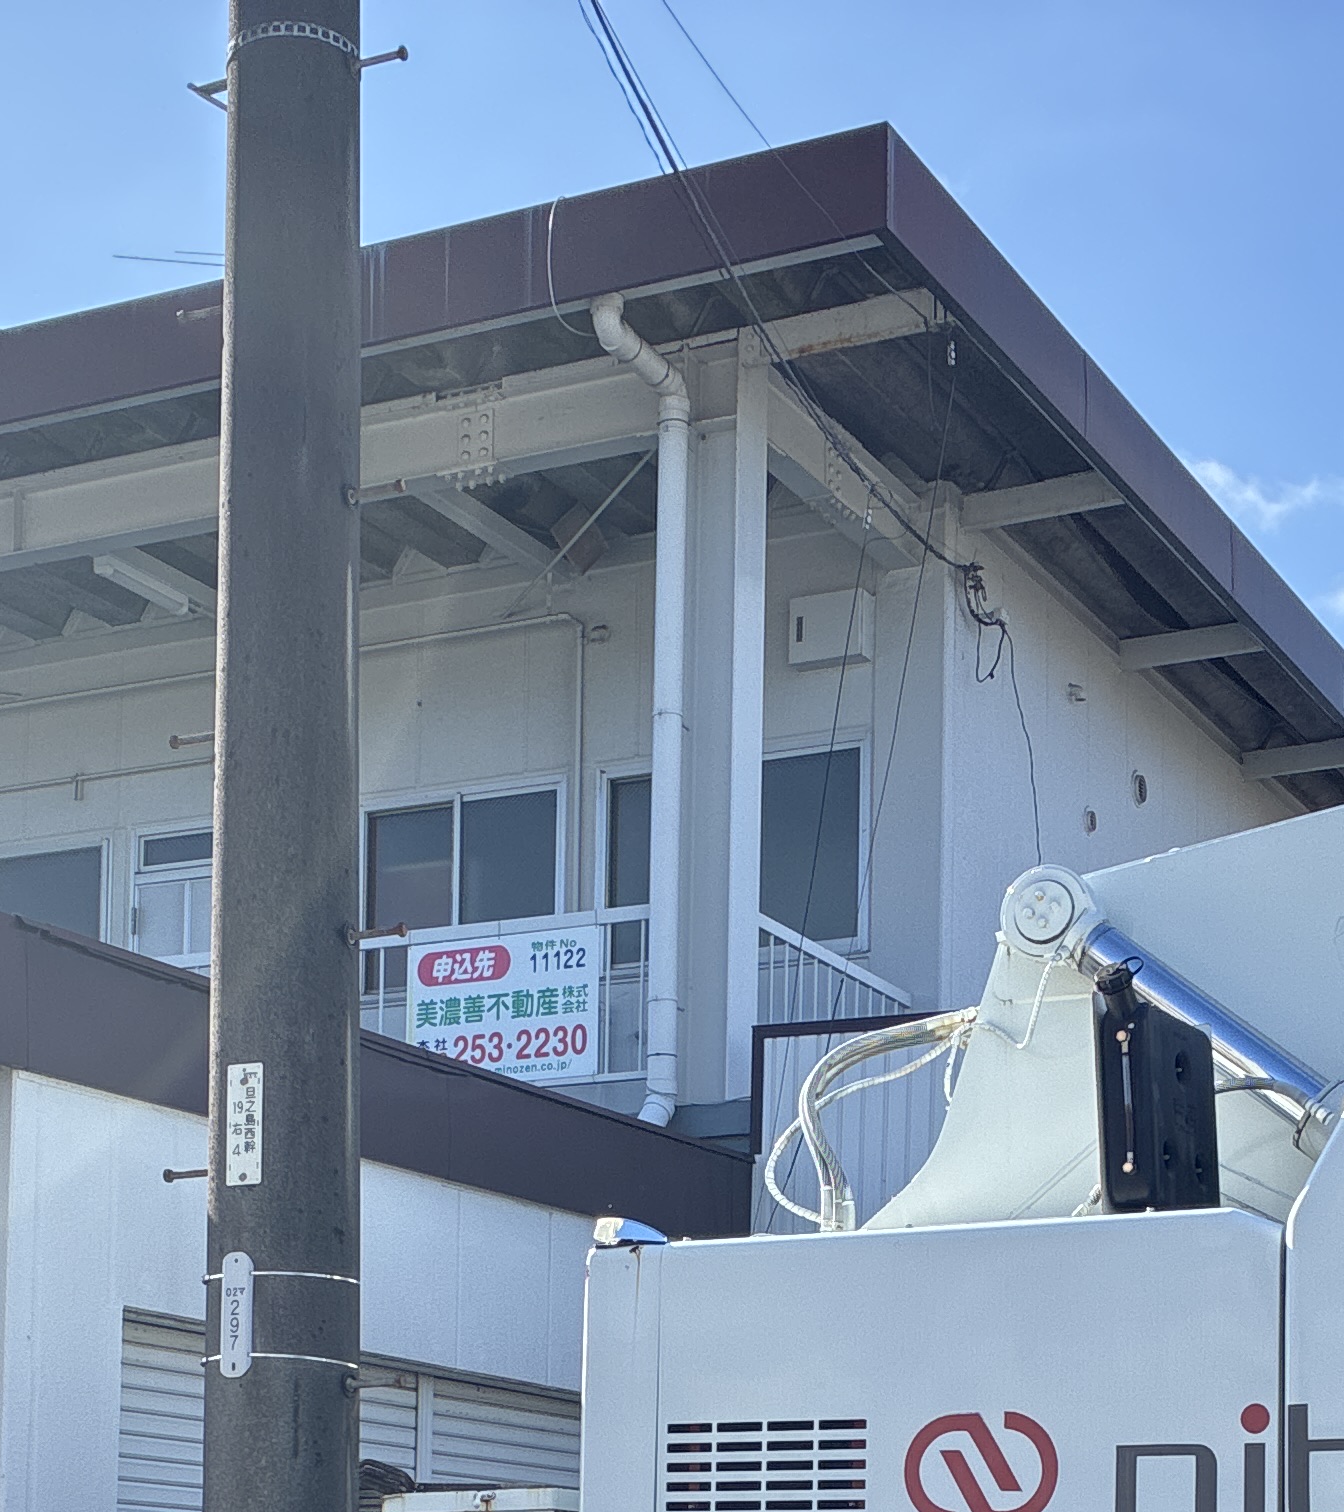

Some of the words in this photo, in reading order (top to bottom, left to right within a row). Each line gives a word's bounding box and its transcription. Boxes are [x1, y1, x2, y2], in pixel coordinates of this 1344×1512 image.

[432, 949, 496, 983] 申込先
[529, 947, 587, 974] 11122
[415, 986, 560, 1029] 美濃善不動産
